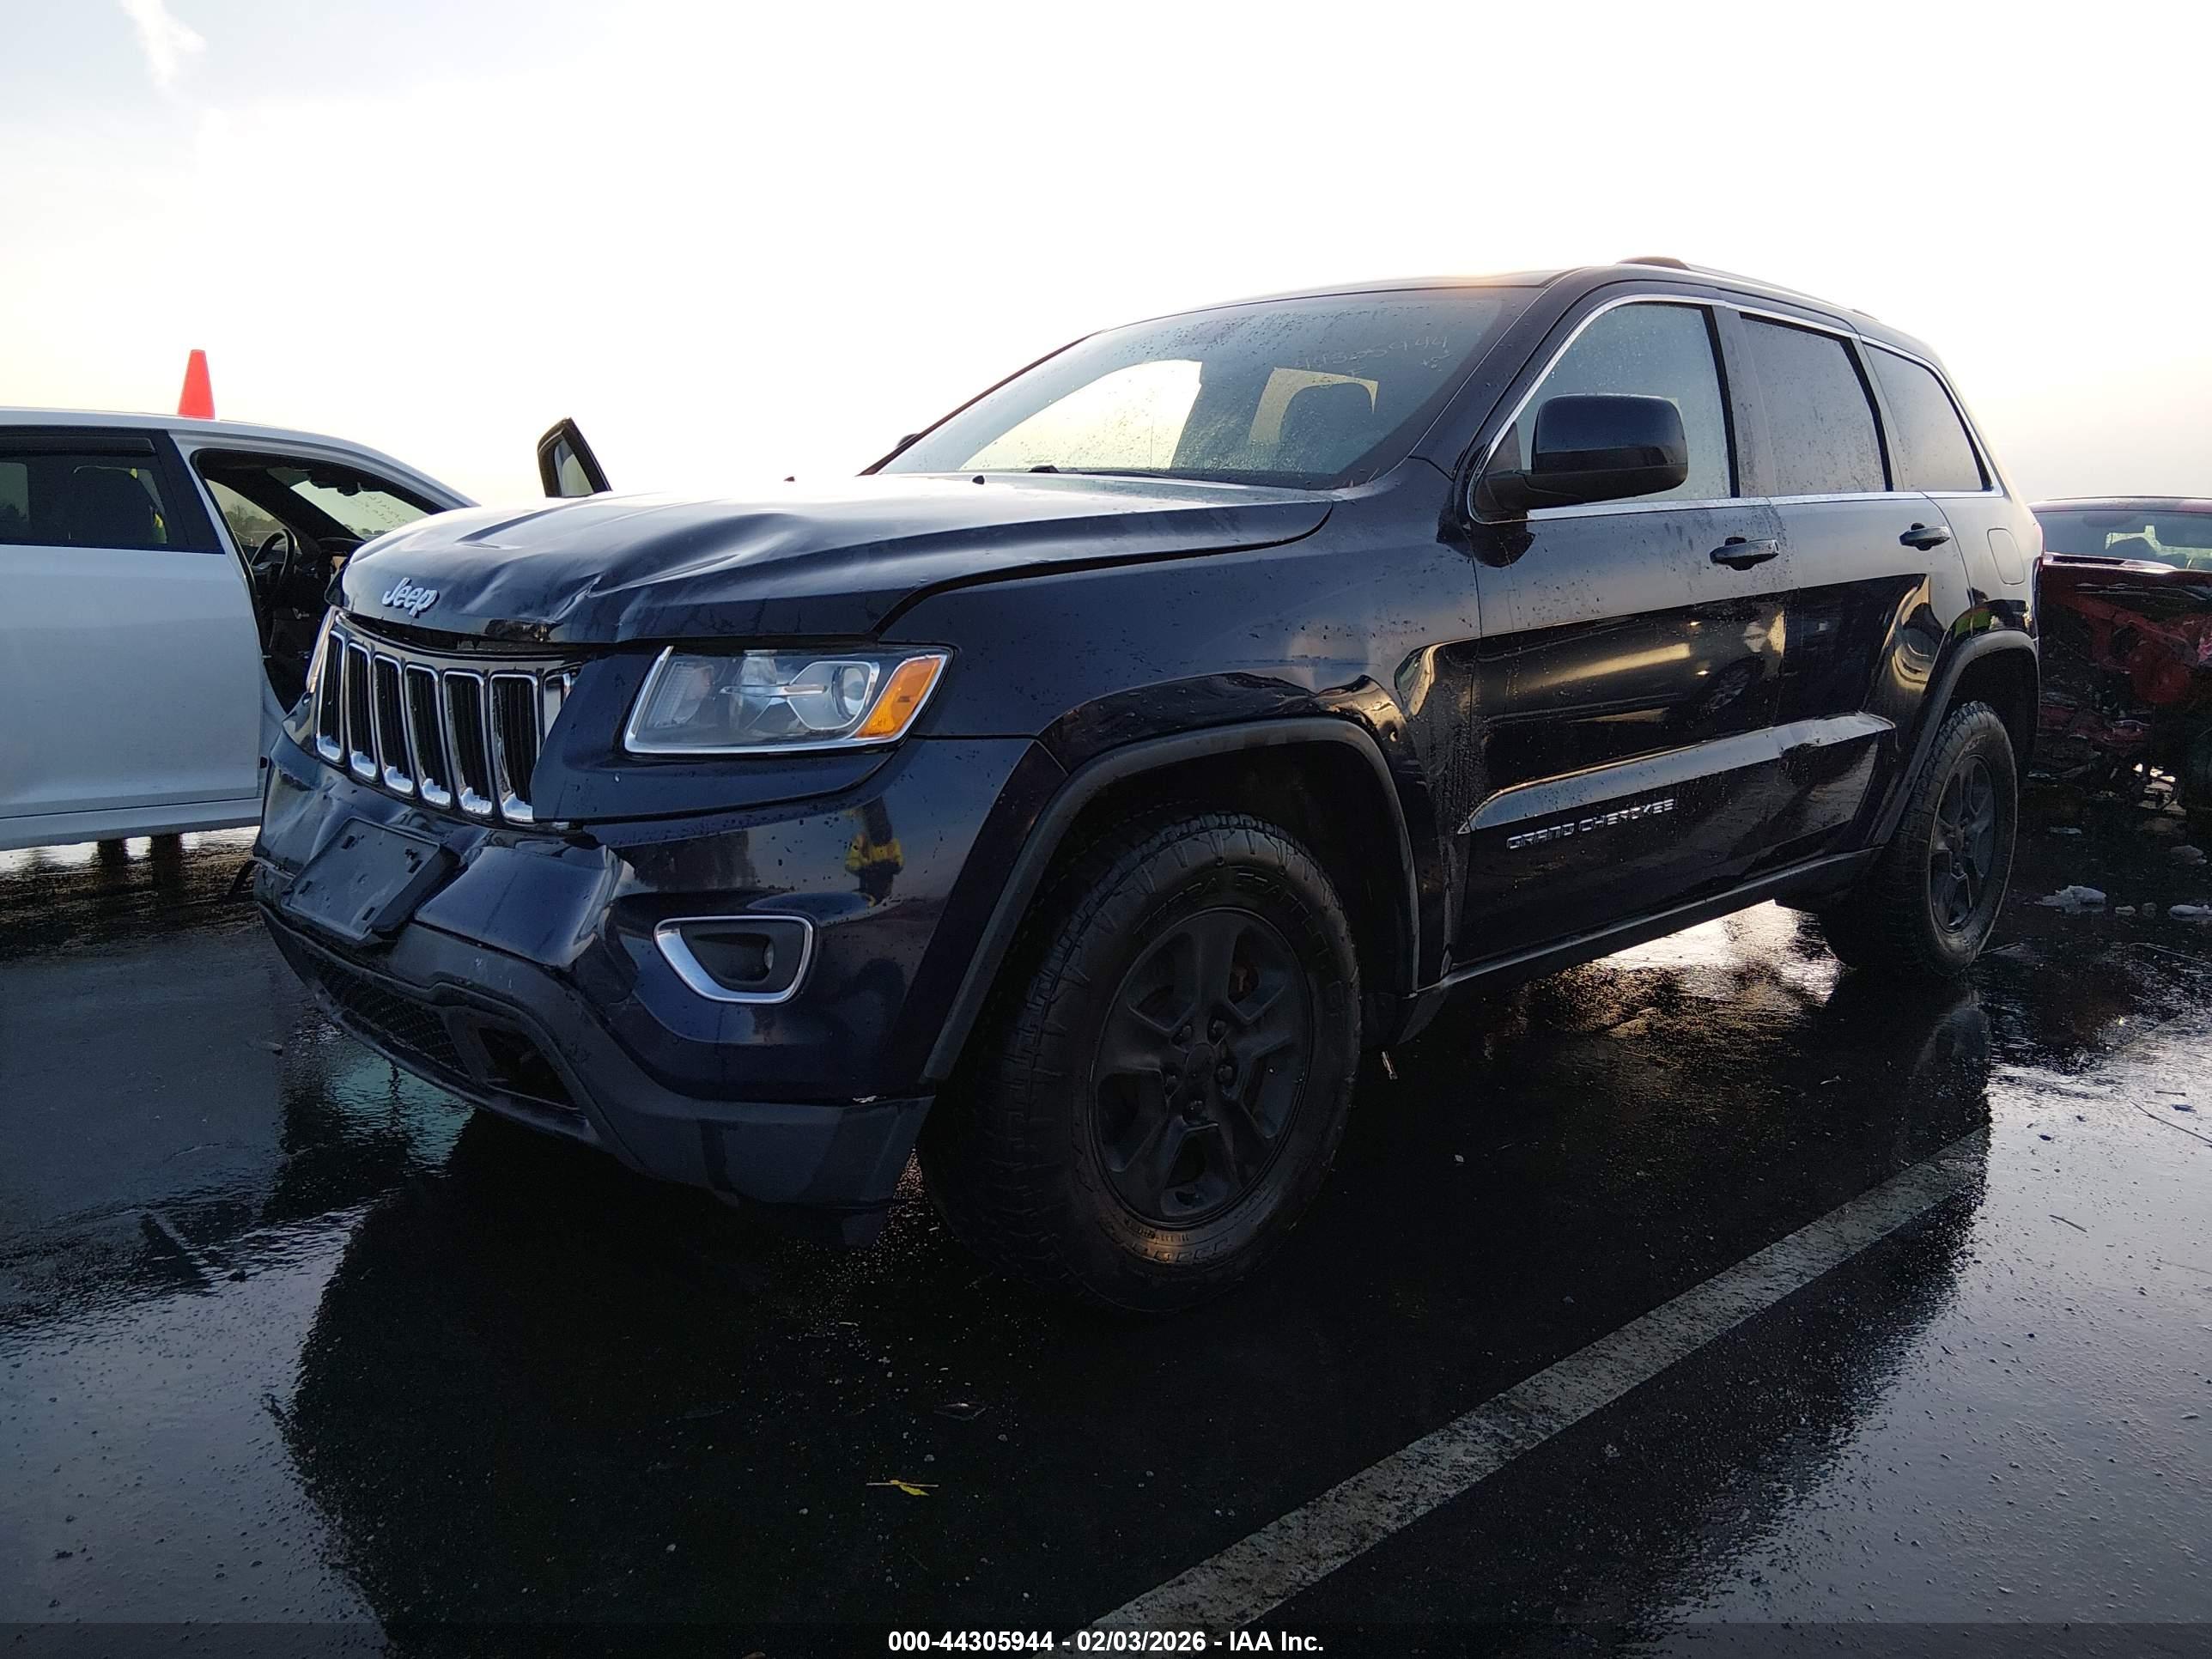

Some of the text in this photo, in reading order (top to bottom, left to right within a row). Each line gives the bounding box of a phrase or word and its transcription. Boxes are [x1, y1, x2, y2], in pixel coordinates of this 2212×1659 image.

[382, 577, 438, 618] Jeep
[1506, 798, 1675, 850] GRAND CHEROKEE
